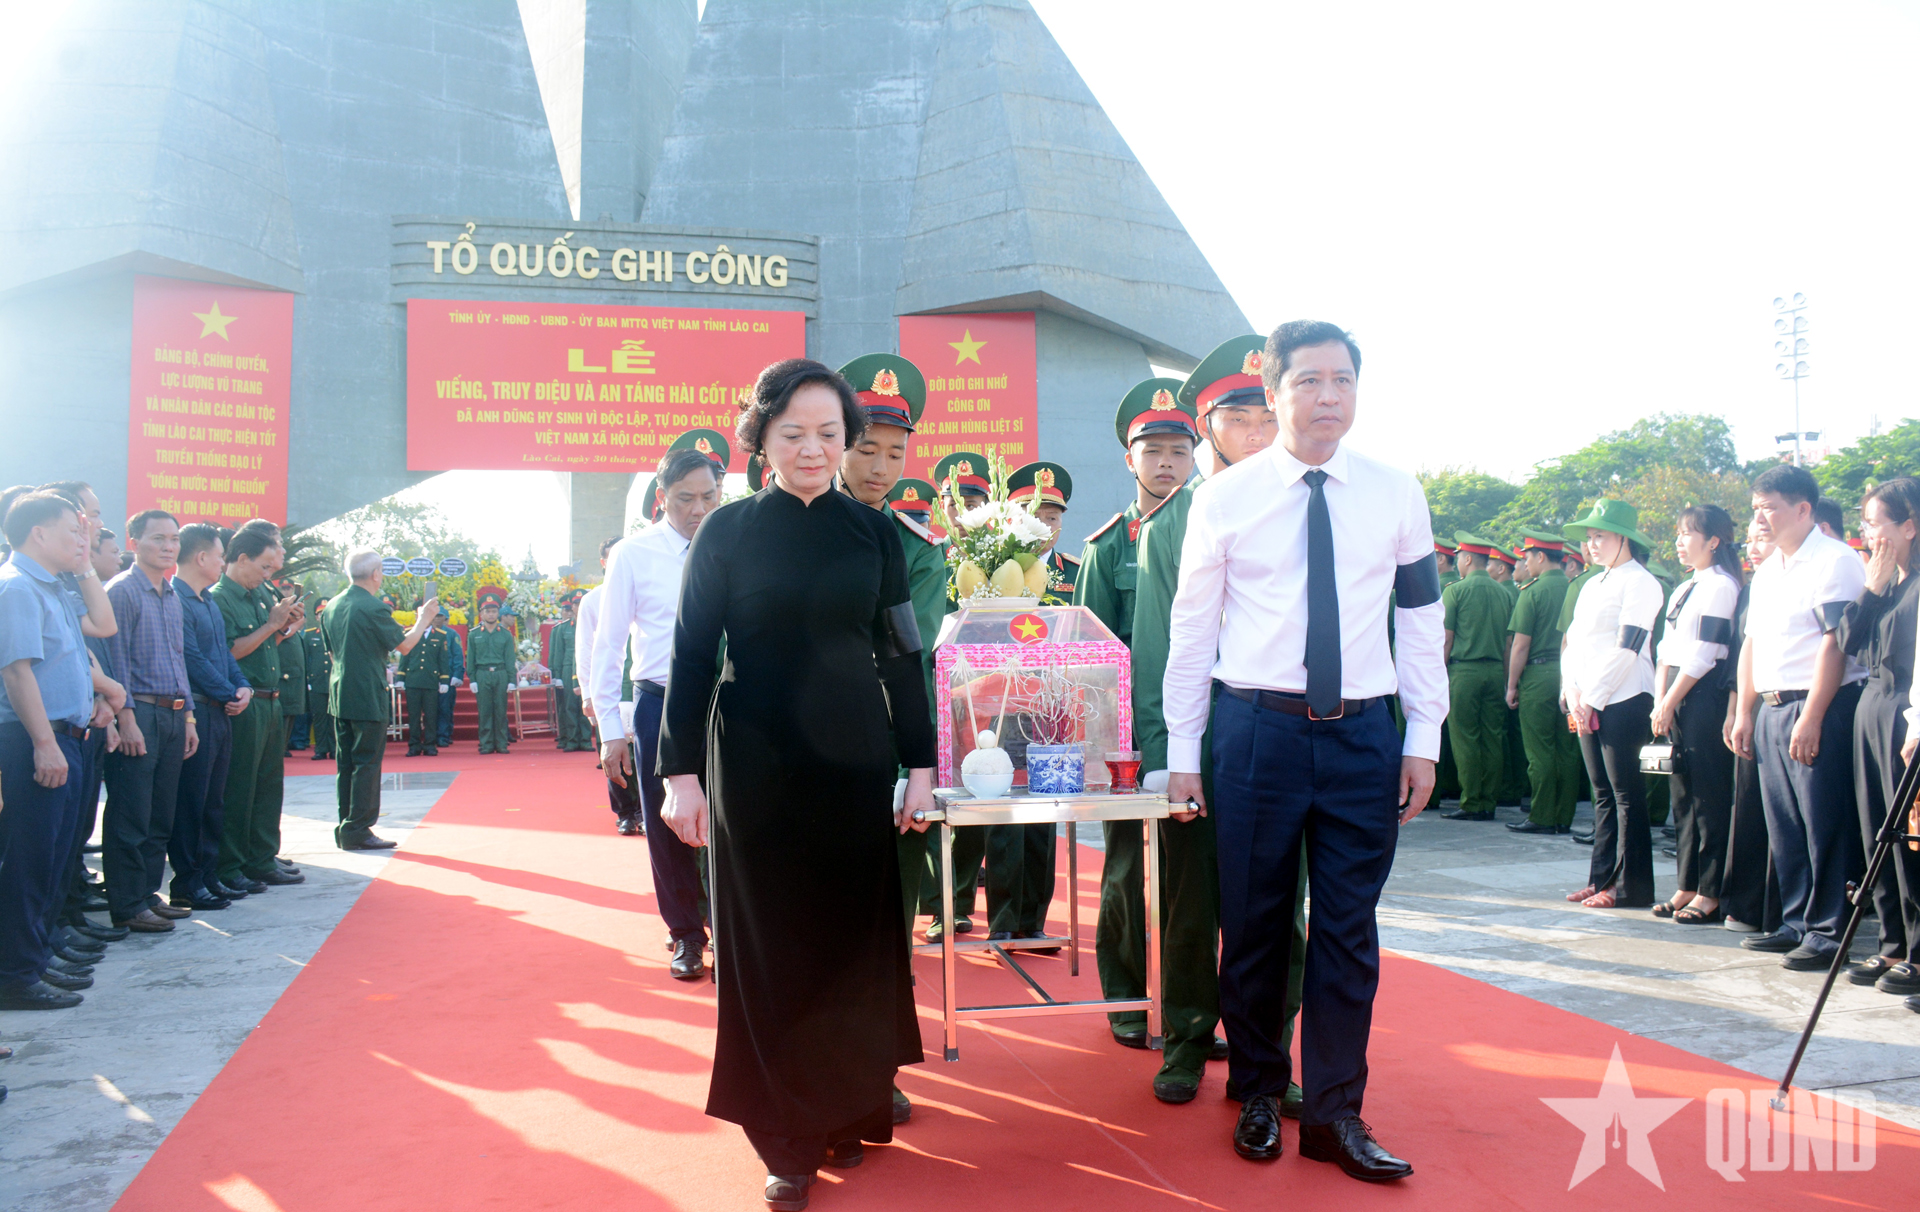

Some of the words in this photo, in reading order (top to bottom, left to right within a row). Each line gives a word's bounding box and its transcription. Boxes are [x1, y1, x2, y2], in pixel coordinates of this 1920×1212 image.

[426, 221, 479, 276] TỔ
[489, 231, 600, 280] QUỐC
[611, 247, 673, 284] GHI
[685, 244, 789, 288] CÔNG
[449, 310, 473, 323] TỈNH
[477, 310, 491, 324] ỦY
[502, 314, 530, 325] HĐND
[541, 315, 568, 326] UBND
[579, 313, 593, 327] ỦY
[597, 317, 617, 327] BAN
[621, 318, 648, 329] MTTQ
[652, 317, 675, 331] VIỆT
[678, 320, 700, 330] NAM
[703, 318, 726, 331] TỈNH
[730, 319, 749, 332] LÀO
[753, 322, 769, 332] CAI
[155, 344, 182, 364] ĐẢNG
[184, 349, 201, 368] BỘ,
[204, 352, 233, 369] CHÍNH
[568, 339, 656, 374] LỄ
[161, 372, 180, 389] LỰC
[182, 374, 214, 392] LƯỢNG
[217, 376, 229, 391] VŨ
[232, 379, 263, 395] TRANG
[436, 374, 487, 401] VIẾNG,
[492, 381, 531, 400] TRUY
[535, 379, 570, 405] ĐIỆU
[575, 380, 595, 401] VÀ
[599, 384, 621, 402] AN
[625, 381, 665, 403] TÁNG
[669, 382, 694, 403] HÀI
[699, 381, 727, 404] CỐT
[929, 376, 946, 391] ĐỜI
[949, 375, 965, 391] ĐỜI
[968, 377, 984, 390] GHI
[987, 373, 1008, 389] NHỚ
[146, 395, 159, 411] VÀ
[161, 397, 189, 414] NHÂN
[191, 399, 212, 416] DÂN
[214, 401, 233, 417] CÁC
[236, 403, 255, 419] DÂN
[258, 404, 275, 423] TỘC
[948, 397, 974, 412] CÔNG
[977, 398, 990, 411] ƠN
[457, 407, 473, 422] ĐÃ
[476, 410, 500, 423] ANH
[503, 408, 534, 423] DŨNG
[538, 411, 553, 424] HY
[557, 412, 582, 424] SINH
[586, 409, 597, 424] VÌ
[600, 410, 623, 427] ĐỘC
[627, 410, 652, 428] LẬP,
[654, 412, 670, 428] TỰ
[673, 414, 688, 426] DO
[692, 410, 713, 427] CỦA
[716, 410, 731, 427] TỔ
[916, 420, 935, 435] CÁC
[938, 421, 958, 434] ANH
[961, 419, 988, 433] HÙNG
[991, 418, 1010, 435] LIỆT
[1013, 417, 1023, 432] SĨ
[143, 419, 166, 438] TỈNH
[168, 423, 187, 439] LÀO
[189, 426, 206, 441] CAI
[208, 428, 232, 445] THỰC
[235, 428, 257, 447] HIỆN
[260, 429, 276, 446] TỐT
[535, 429, 561, 446] VIỆT
[564, 432, 589, 444] NAM
[592, 430, 607, 445] XÃ
[610, 430, 630, 447] HỘI
[633, 429, 655, 446] CHỦ
[156, 447, 194, 465] TRUYỀN
[196, 449, 227, 467] THỐNG
[230, 454, 249, 471] ĐẠO
[252, 454, 263, 470] LÝ
[523, 454, 542, 462] Lào
[544, 454, 563, 463] Cai,
[567, 456, 589, 464] ngày
[610, 455, 638, 464] tháng
[917, 443, 930, 457] ĐÃ
[933, 444, 953, 457] ANH
[1000, 442, 1024, 457] SINH
[147, 471, 179, 489] “UỐNG
[181, 473, 208, 491] NƯỚC
[210, 475, 231, 492] NHỚ
[233, 477, 269, 495] NGUỒN”
[184, 500, 198, 515] ƠN
[200, 500, 219, 516] ĐÁP
